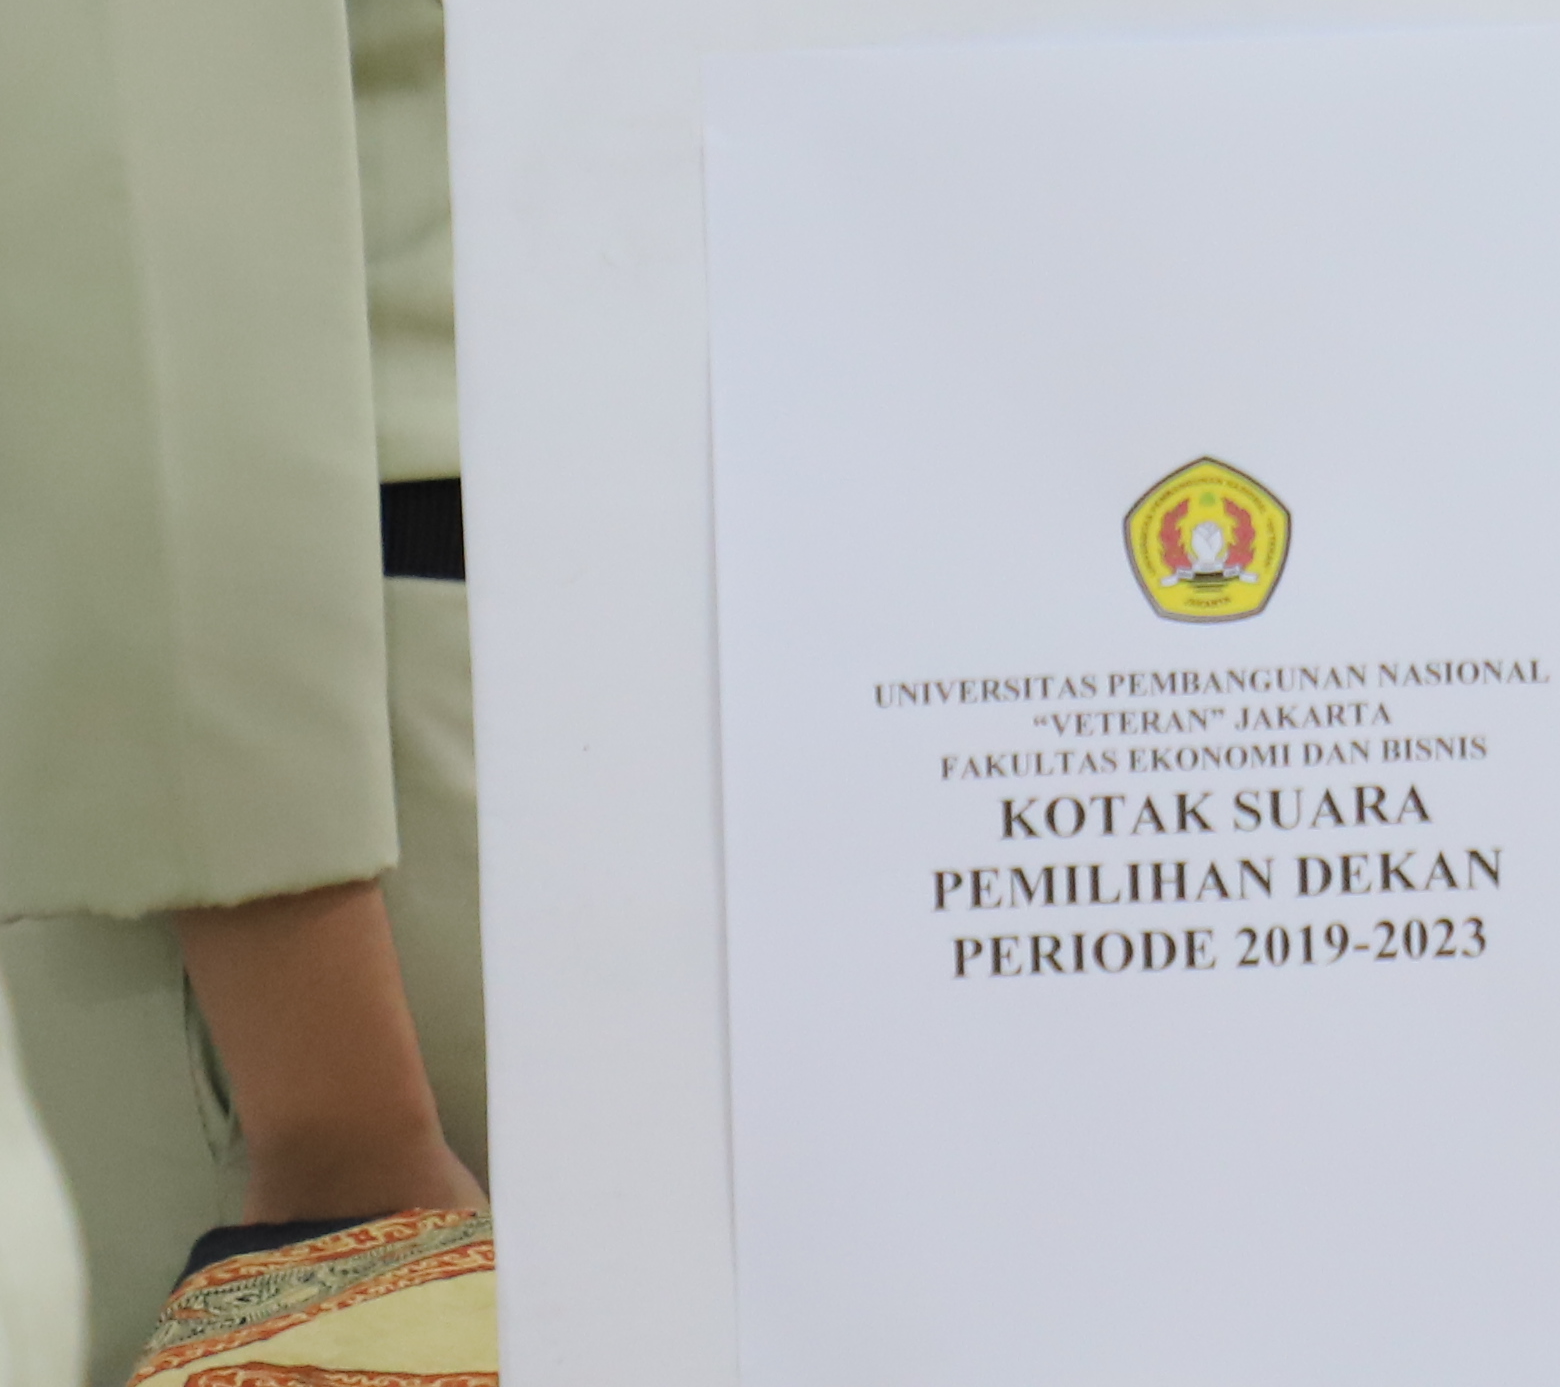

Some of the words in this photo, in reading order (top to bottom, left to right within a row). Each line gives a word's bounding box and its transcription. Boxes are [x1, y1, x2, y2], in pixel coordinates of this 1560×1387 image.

[875, 674, 1098, 708] UNIVERSITAS
[1107, 664, 1368, 699] PEMBANGUNAN
[1378, 659, 1550, 688] NASIONAL
[1234, 701, 1393, 731] JAKARTA
[940, 747, 1118, 781] FAKULTAS
[1128, 743, 1293, 773] EKONOMI
[1302, 739, 1372, 767] DAN
[1381, 733, 1488, 763] BISNIS
[998, 790, 1218, 841] KOTAK
[1231, 783, 1433, 832] SUARA
[931, 856, 1276, 913] PEMILIHAN
[1296, 847, 1503, 899] DEKAN
[952, 927, 1217, 980] PERIODE
[1238, 915, 1489, 969] 2019-2023
